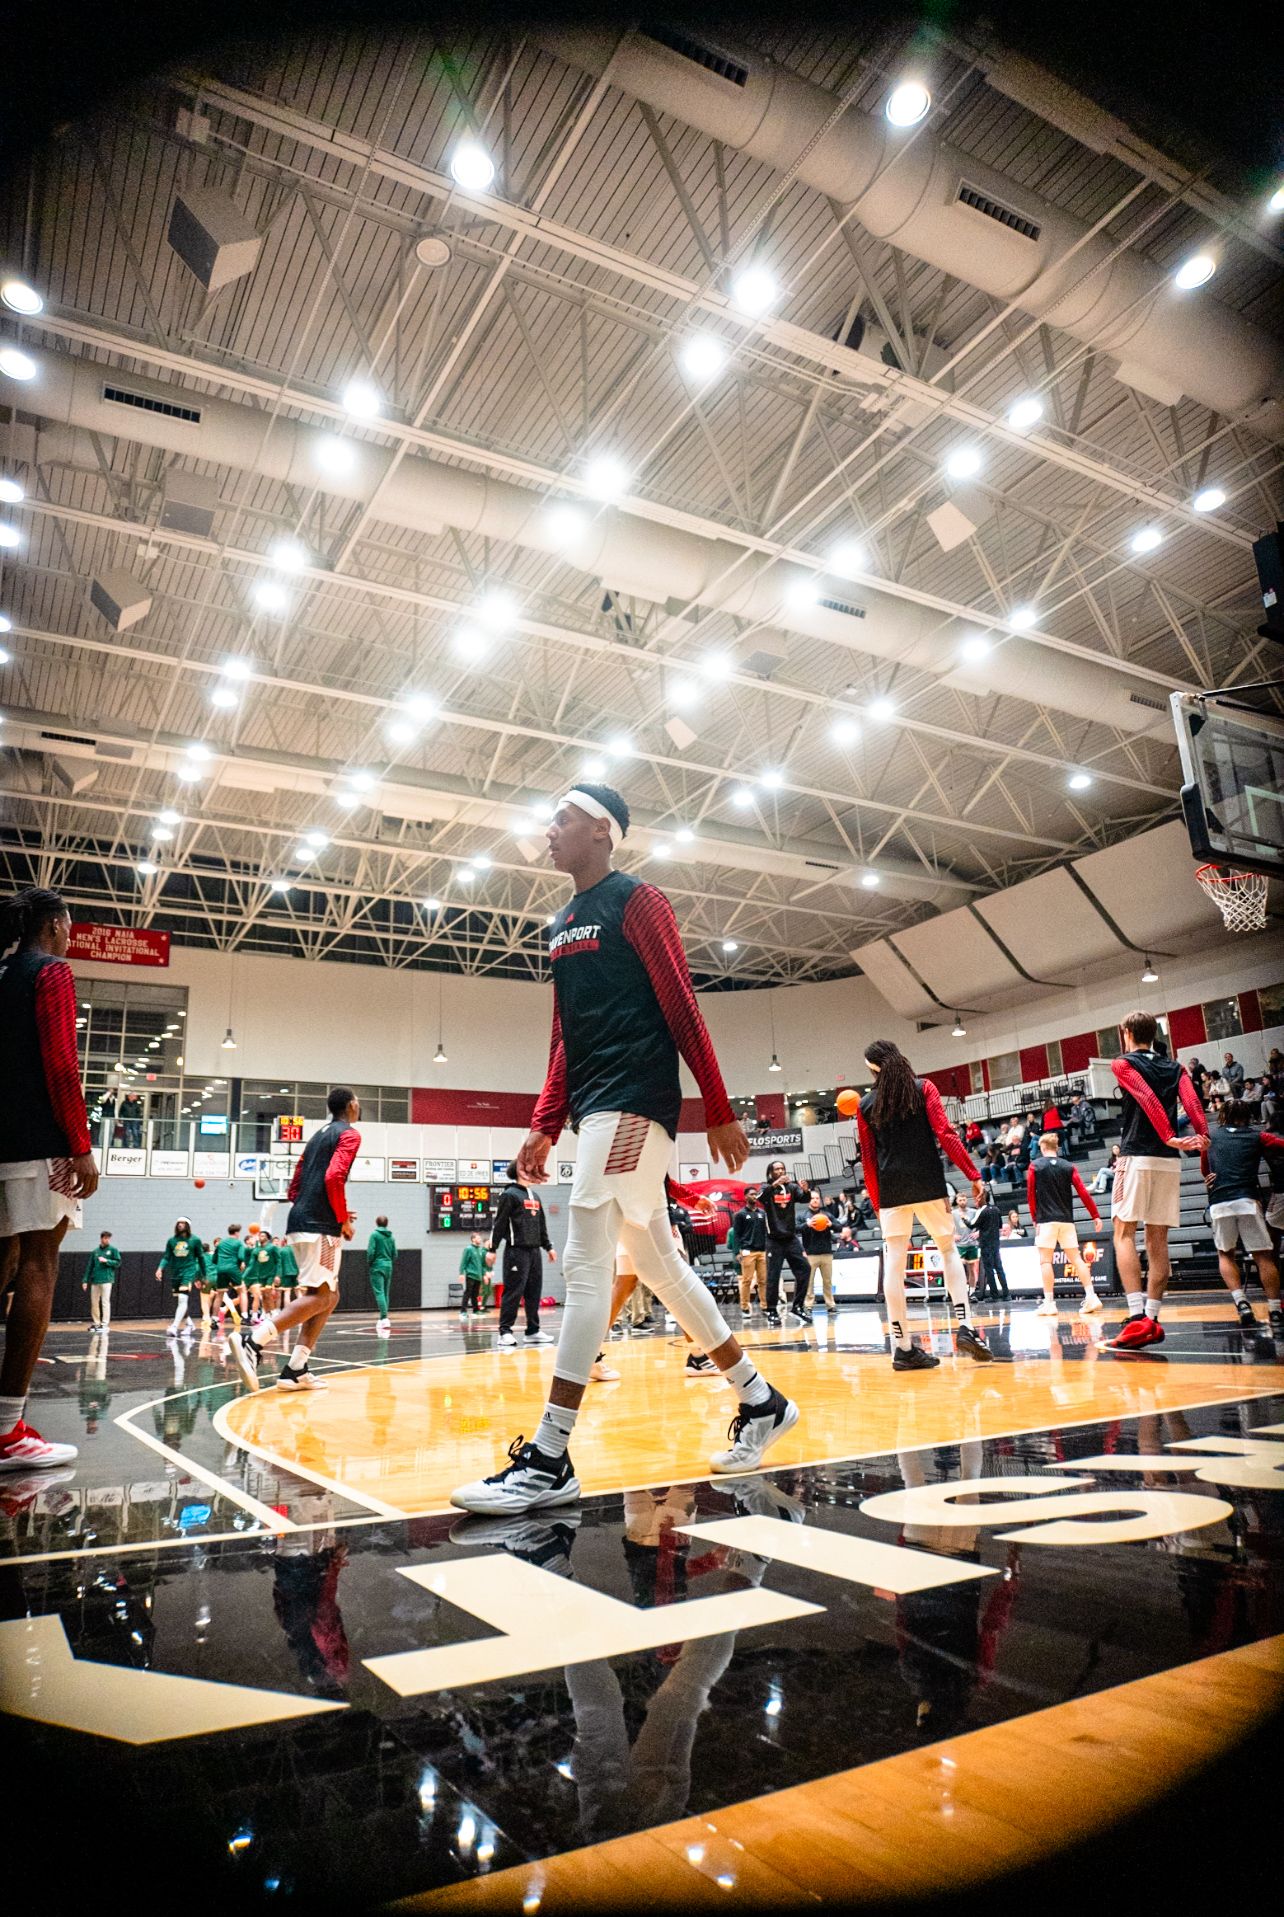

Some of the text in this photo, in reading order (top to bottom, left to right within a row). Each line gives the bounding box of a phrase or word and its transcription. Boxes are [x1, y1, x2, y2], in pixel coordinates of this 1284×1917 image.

[92, 927, 134, 939] 2016 NAIA
[549, 925, 601, 953] AVENPORT
[76, 933, 148, 947] MEN'S LACROSSE
[67, 940, 160, 956] ATIONAL INVITATIONAL
[90, 951, 132, 961] CHAMPION
[281, 1126, 301, 1141] 30
[110, 1154, 142, 1165] Berger
[443, 1194, 452, 1206] 0
[458, 1187, 489, 1200] 10:56
